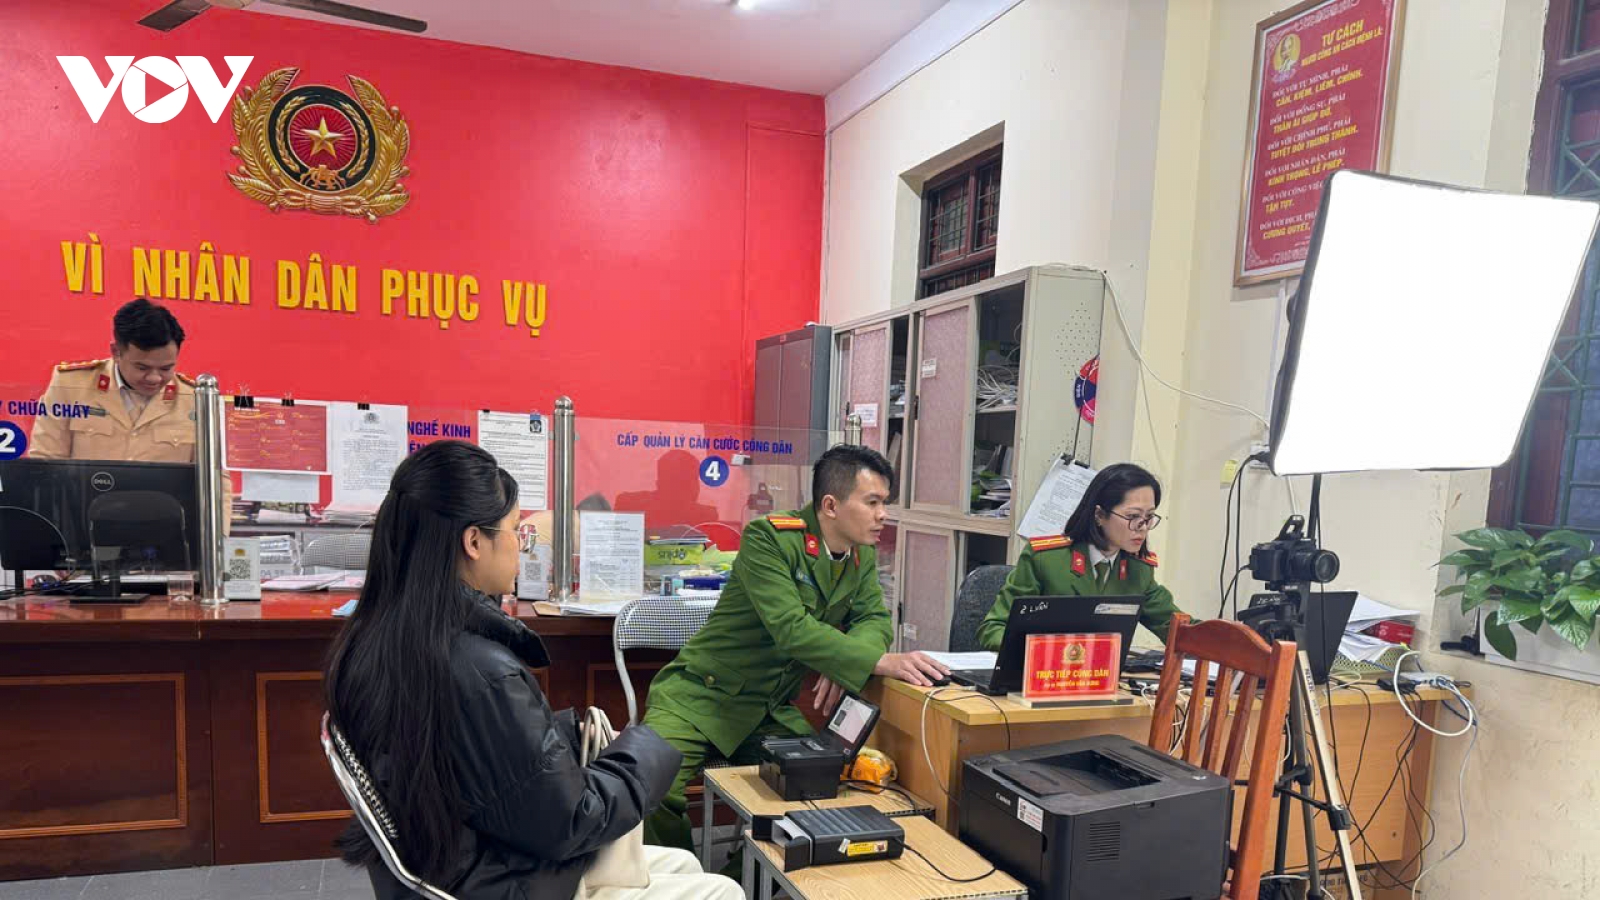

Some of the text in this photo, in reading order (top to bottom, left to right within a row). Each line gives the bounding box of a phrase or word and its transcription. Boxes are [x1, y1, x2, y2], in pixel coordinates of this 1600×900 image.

[1336, 20, 1364, 40] CÁCH
[60, 232, 547, 337] VÌ NHÂN DÂN PHỤC VỤ
[8, 398, 90, 418] CHỮA CHÁY
[0, 428, 16, 453] 2
[442, 424, 470, 438] KINH
[617, 431, 638, 446] CẤP
[644, 431, 670, 448] QUẢN
[674, 434, 686, 448] LÝ
[714, 436, 740, 450] CƯỚC
[742, 438, 770, 452] CÔNG
[772, 440, 792, 454] DÂN
[705, 460, 720, 481] 4
